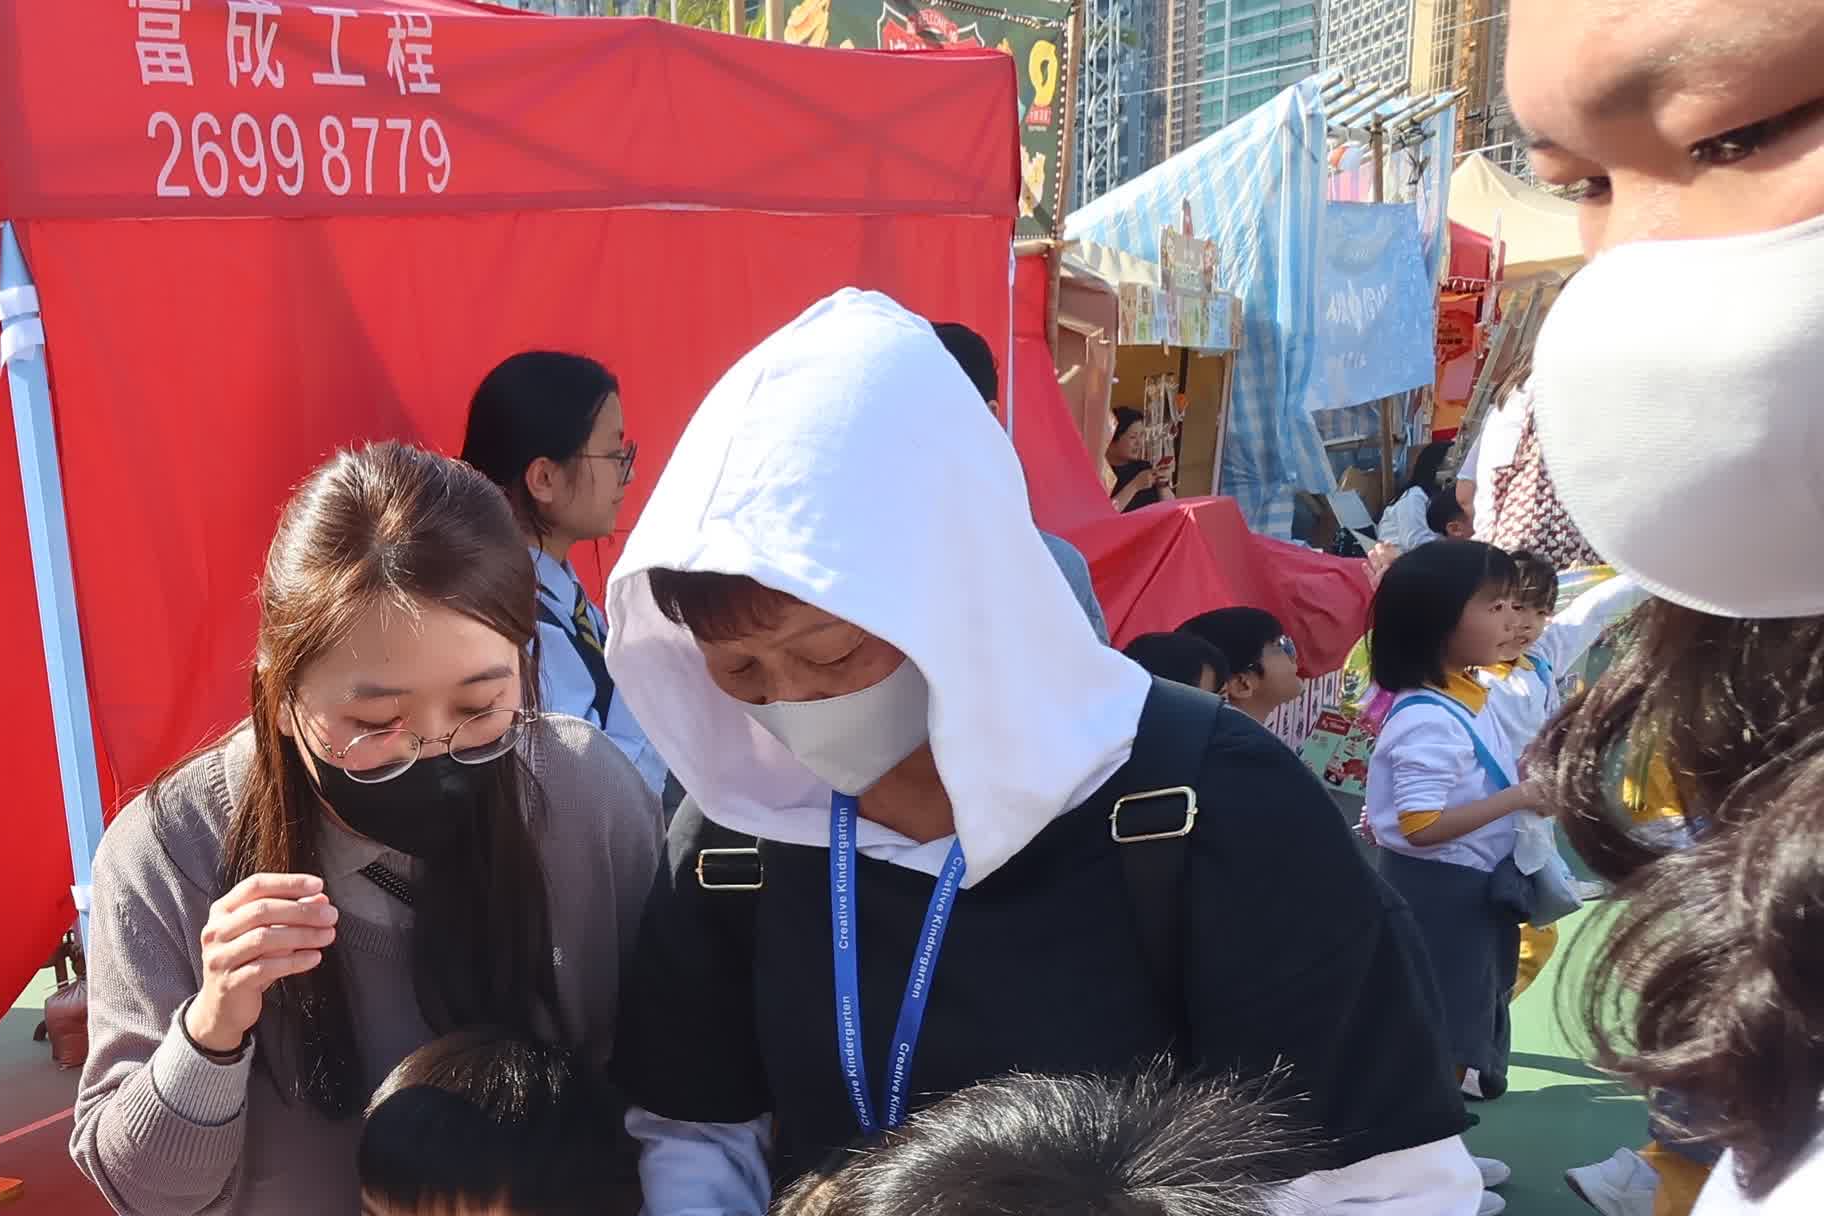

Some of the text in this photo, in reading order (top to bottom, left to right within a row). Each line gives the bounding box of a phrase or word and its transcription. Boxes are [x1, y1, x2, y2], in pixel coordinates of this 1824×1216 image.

[147, 111, 452, 198] 2699 8779
[835, 806, 850, 950] Creative Kindergarten
[912, 856, 964, 1000] Creative Kindergarten
[843, 995, 872, 1127] Creative Kindergarten
[891, 1042, 911, 1093] Creative
